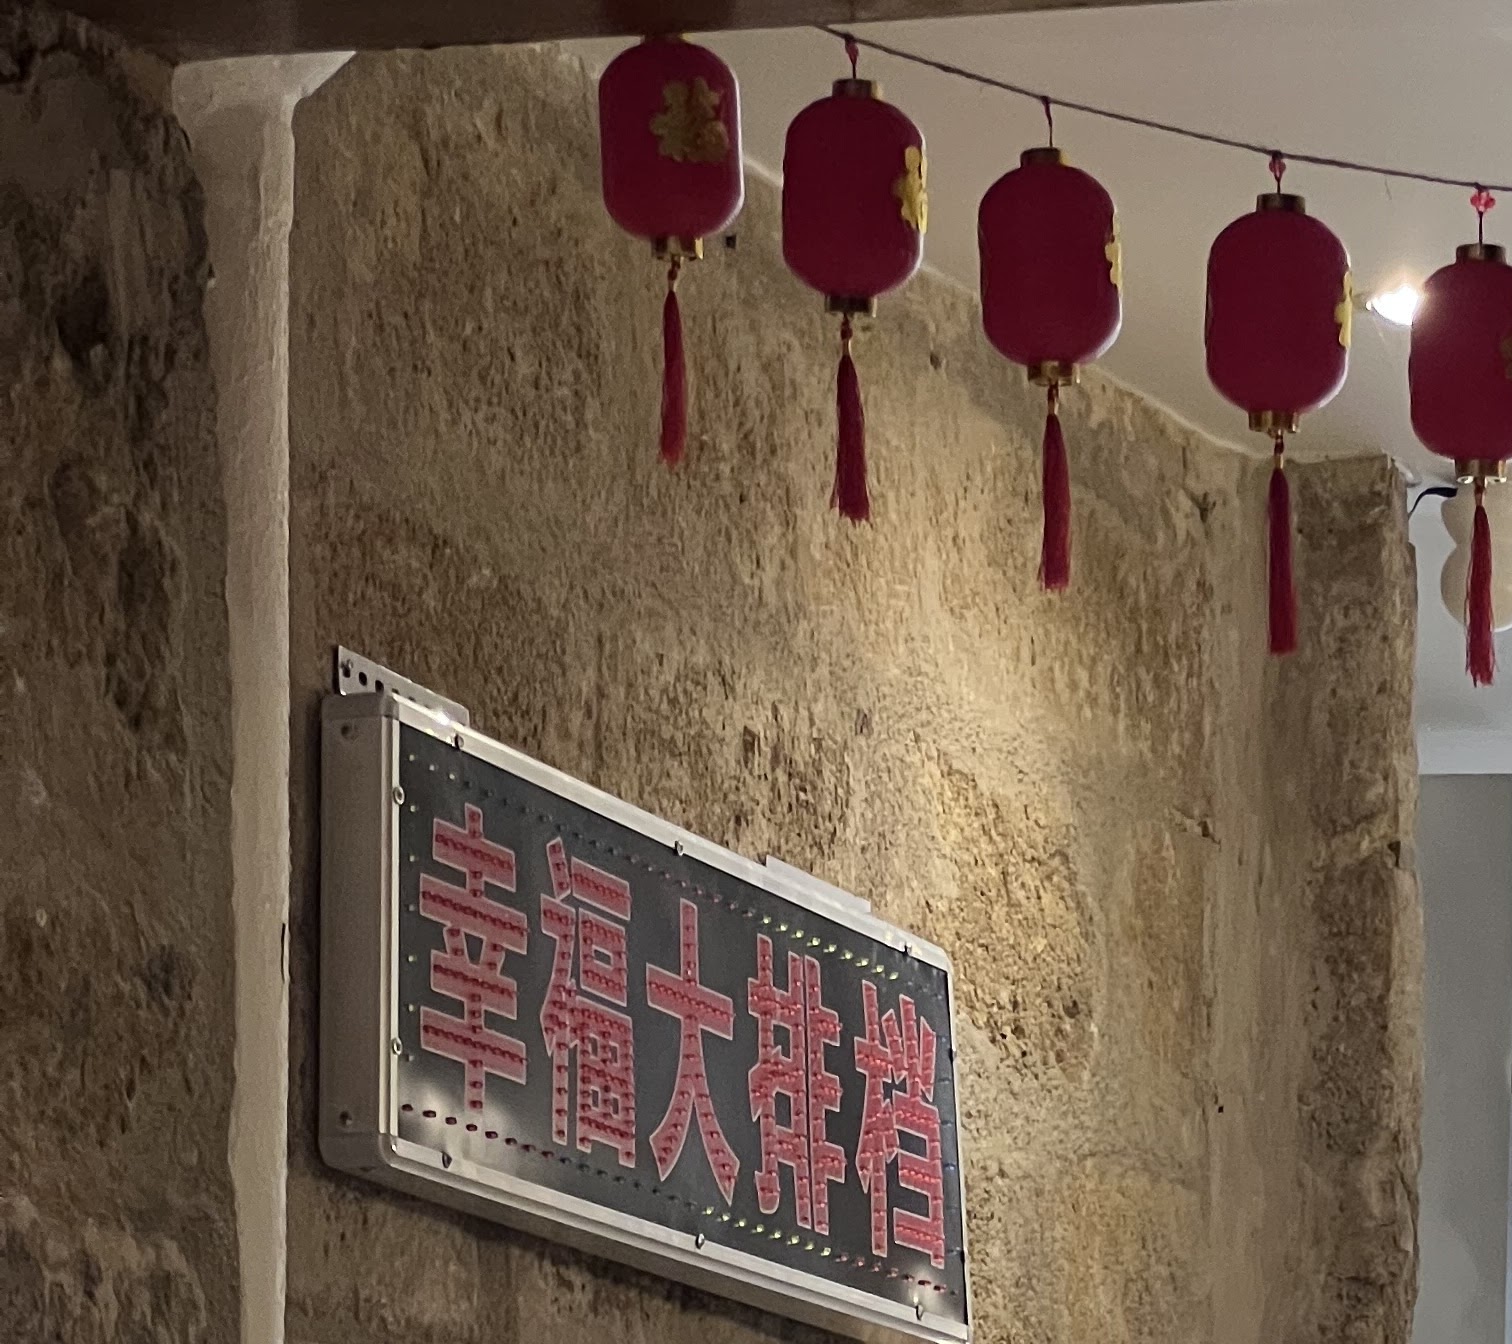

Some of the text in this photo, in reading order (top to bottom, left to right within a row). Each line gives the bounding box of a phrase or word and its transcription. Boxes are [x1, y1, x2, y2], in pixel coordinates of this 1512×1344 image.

[419, 803, 944, 1268] 幸福大排档
